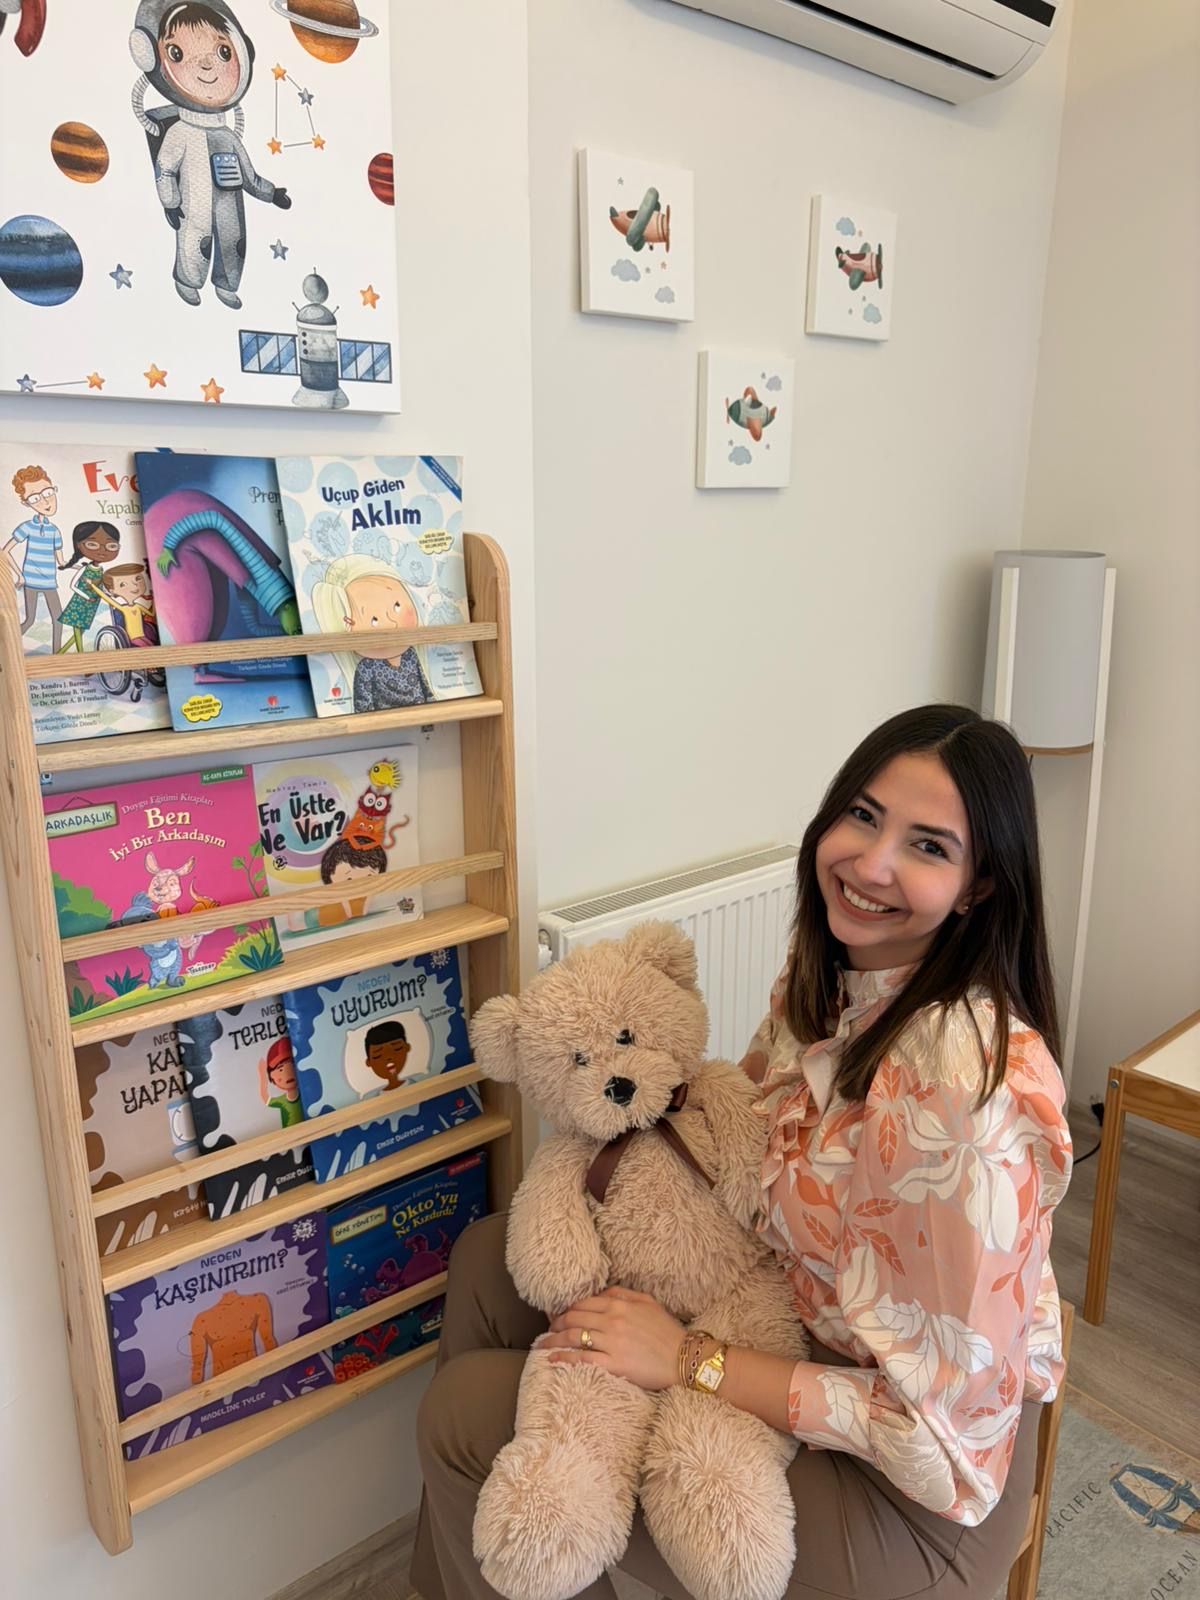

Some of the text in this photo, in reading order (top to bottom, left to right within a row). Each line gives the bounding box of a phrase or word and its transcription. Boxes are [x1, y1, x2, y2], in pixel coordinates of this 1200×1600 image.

[321, 479, 406, 506] Uçup Giden
[351, 499, 422, 532] Aklım
[121, 800, 149, 814] Duygu
[150, 793, 178, 805] Eğitimi
[144, 807, 191, 829] Ben
[257, 791, 336, 827] En Üstte
[45, 811, 113, 831] ARKADAŞLIK
[260, 810, 346, 855] Ne Var?
[109, 828, 226, 861] İyi Bir Arkadaşım
[357, 973, 391, 993] NEDEN
[200, 1247, 242, 1269] NEDEN
[1044, 1481, 1102, 1538] PACIFIC
[1150, 1549, 1199, 1600] OCEAN
